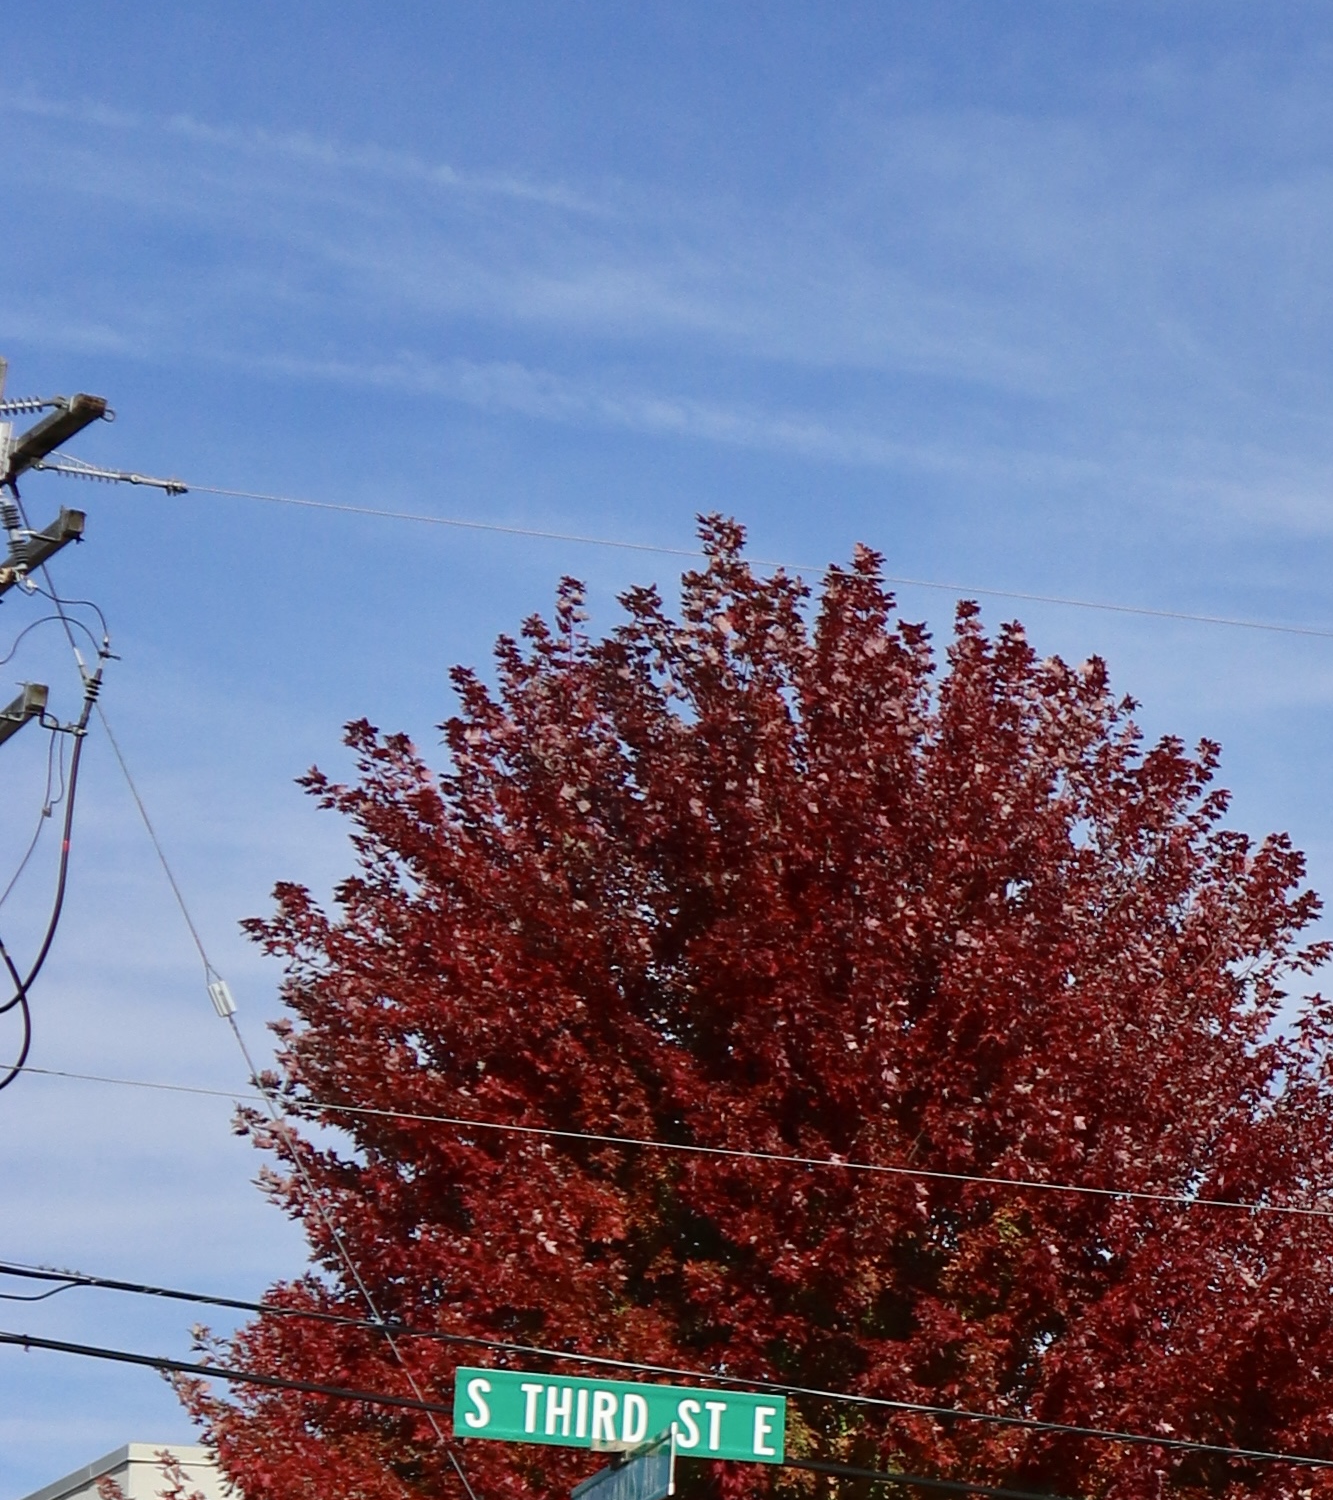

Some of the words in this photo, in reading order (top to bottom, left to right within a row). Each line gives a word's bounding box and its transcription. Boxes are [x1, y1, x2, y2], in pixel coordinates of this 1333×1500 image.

[465, 1378, 491, 1429] S
[520, 1383, 648, 1444] THIRD
[676, 1400, 727, 1451] ST
[753, 1406, 776, 1456] E
